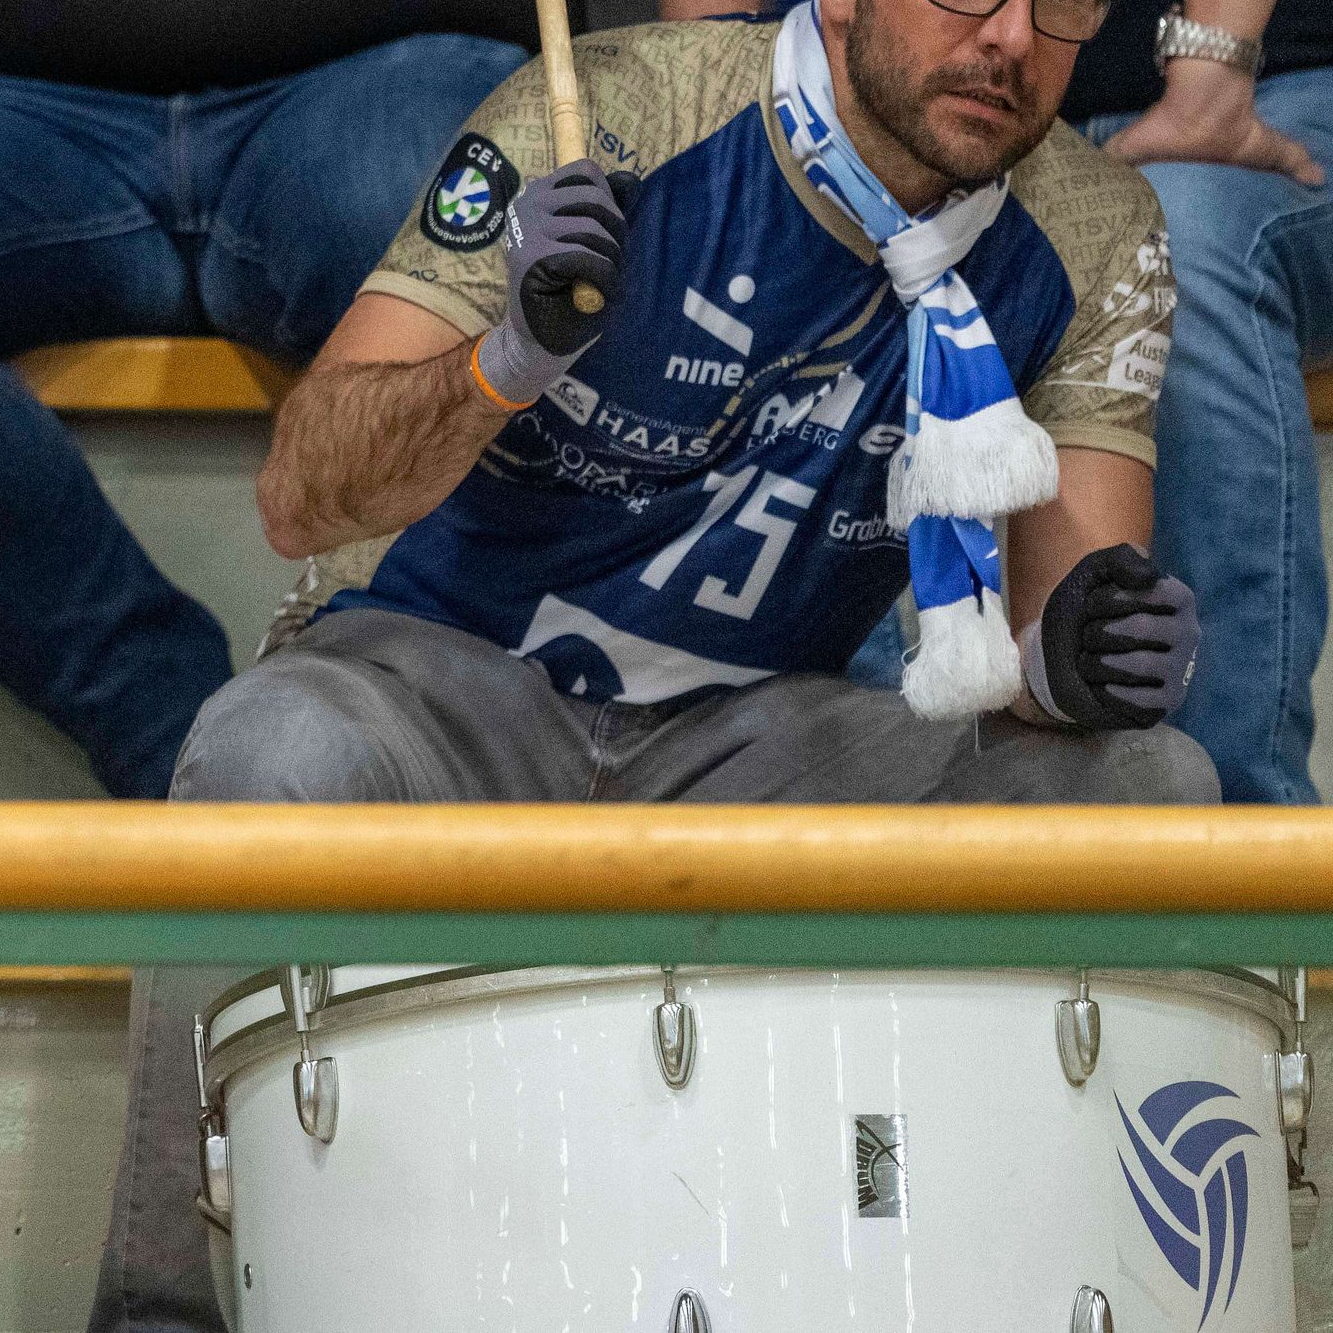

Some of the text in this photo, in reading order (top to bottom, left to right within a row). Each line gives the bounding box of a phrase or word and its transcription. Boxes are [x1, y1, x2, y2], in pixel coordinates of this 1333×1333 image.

[594, 119, 635, 164] TSV
[665, 355, 745, 387] nine
[596, 408, 713, 458] HAAS
[856, 1136, 880, 1211] DRUM
